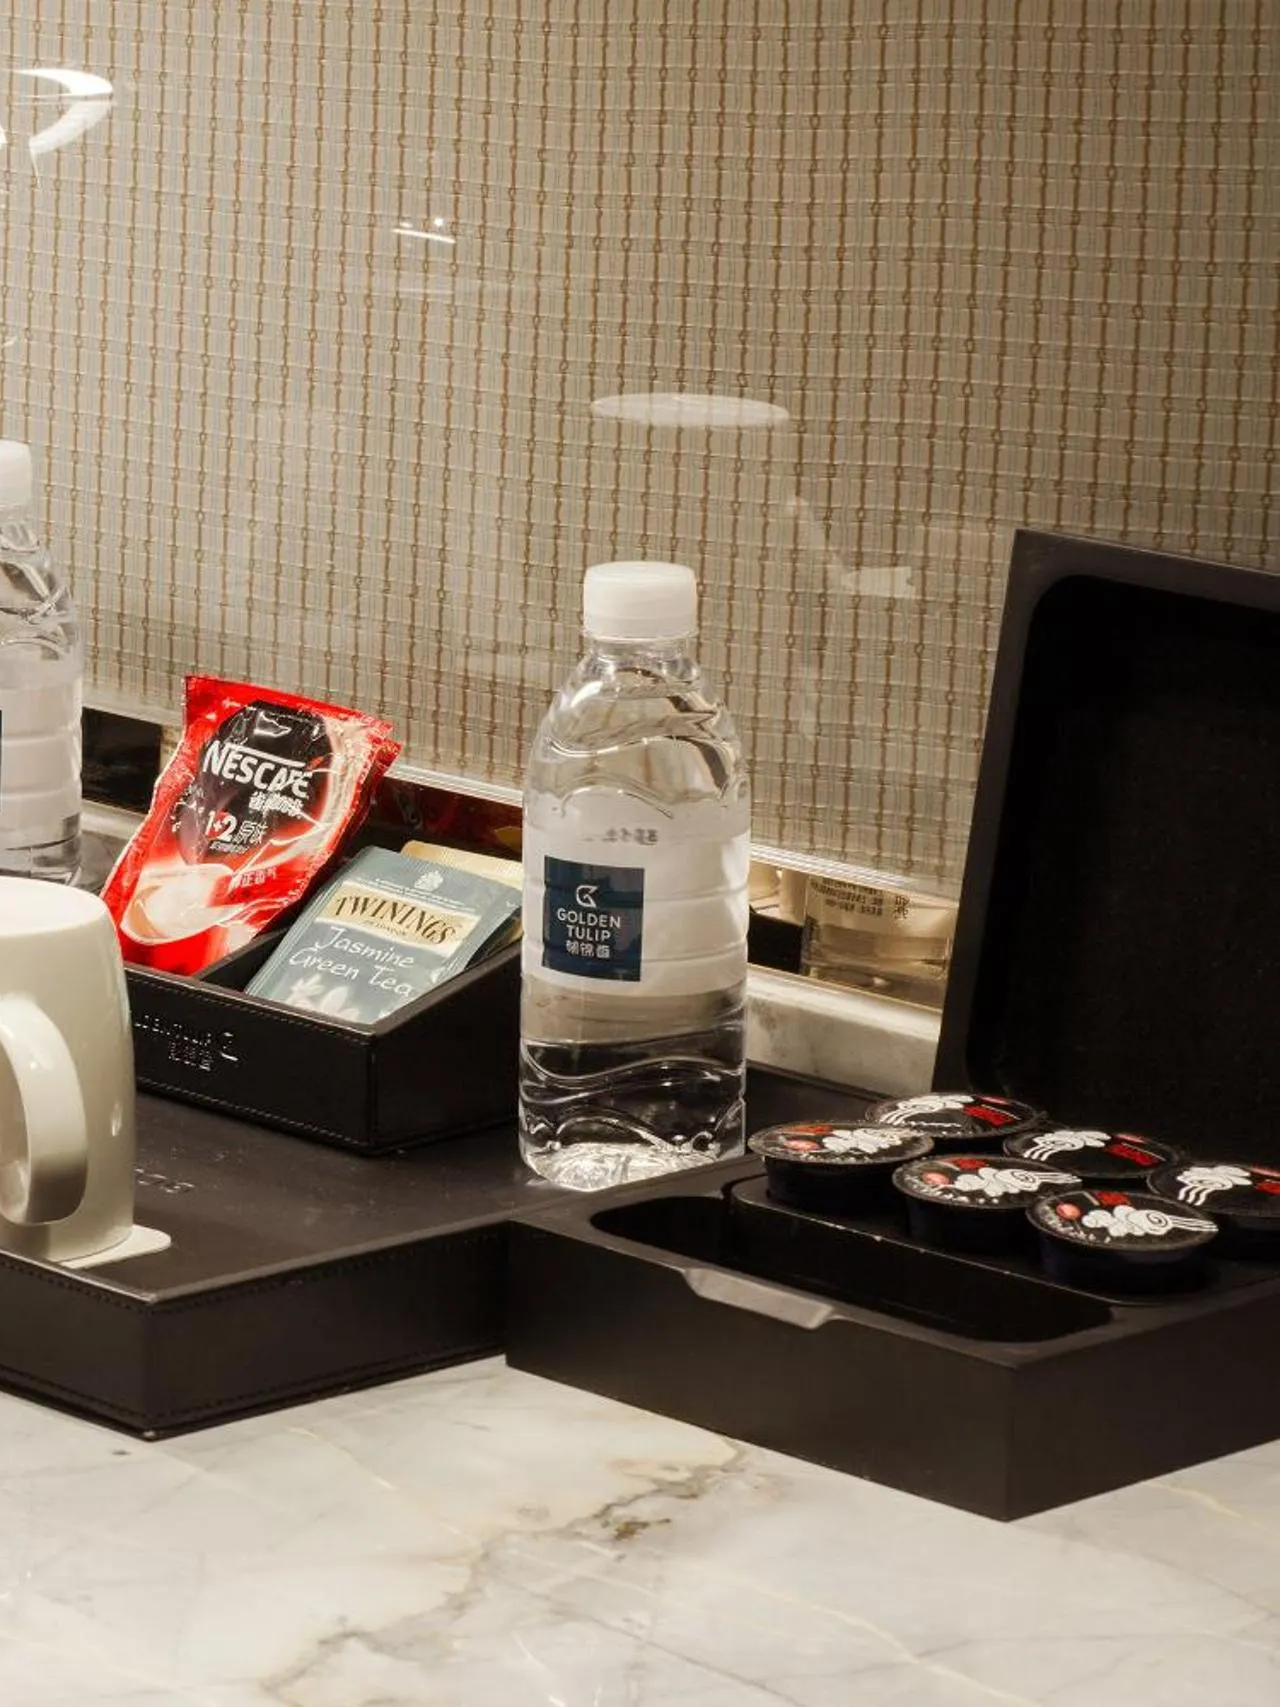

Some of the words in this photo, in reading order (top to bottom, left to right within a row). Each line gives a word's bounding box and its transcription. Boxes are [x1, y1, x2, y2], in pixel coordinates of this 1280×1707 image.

[335, 896, 456, 944] TWININGS
[557, 907, 621, 929] GOLDEN
[566, 924, 611, 942] TULIP
[315, 926, 416, 968] Jasmine
[288, 944, 361, 980] Green
[369, 964, 414, 997] Tea
